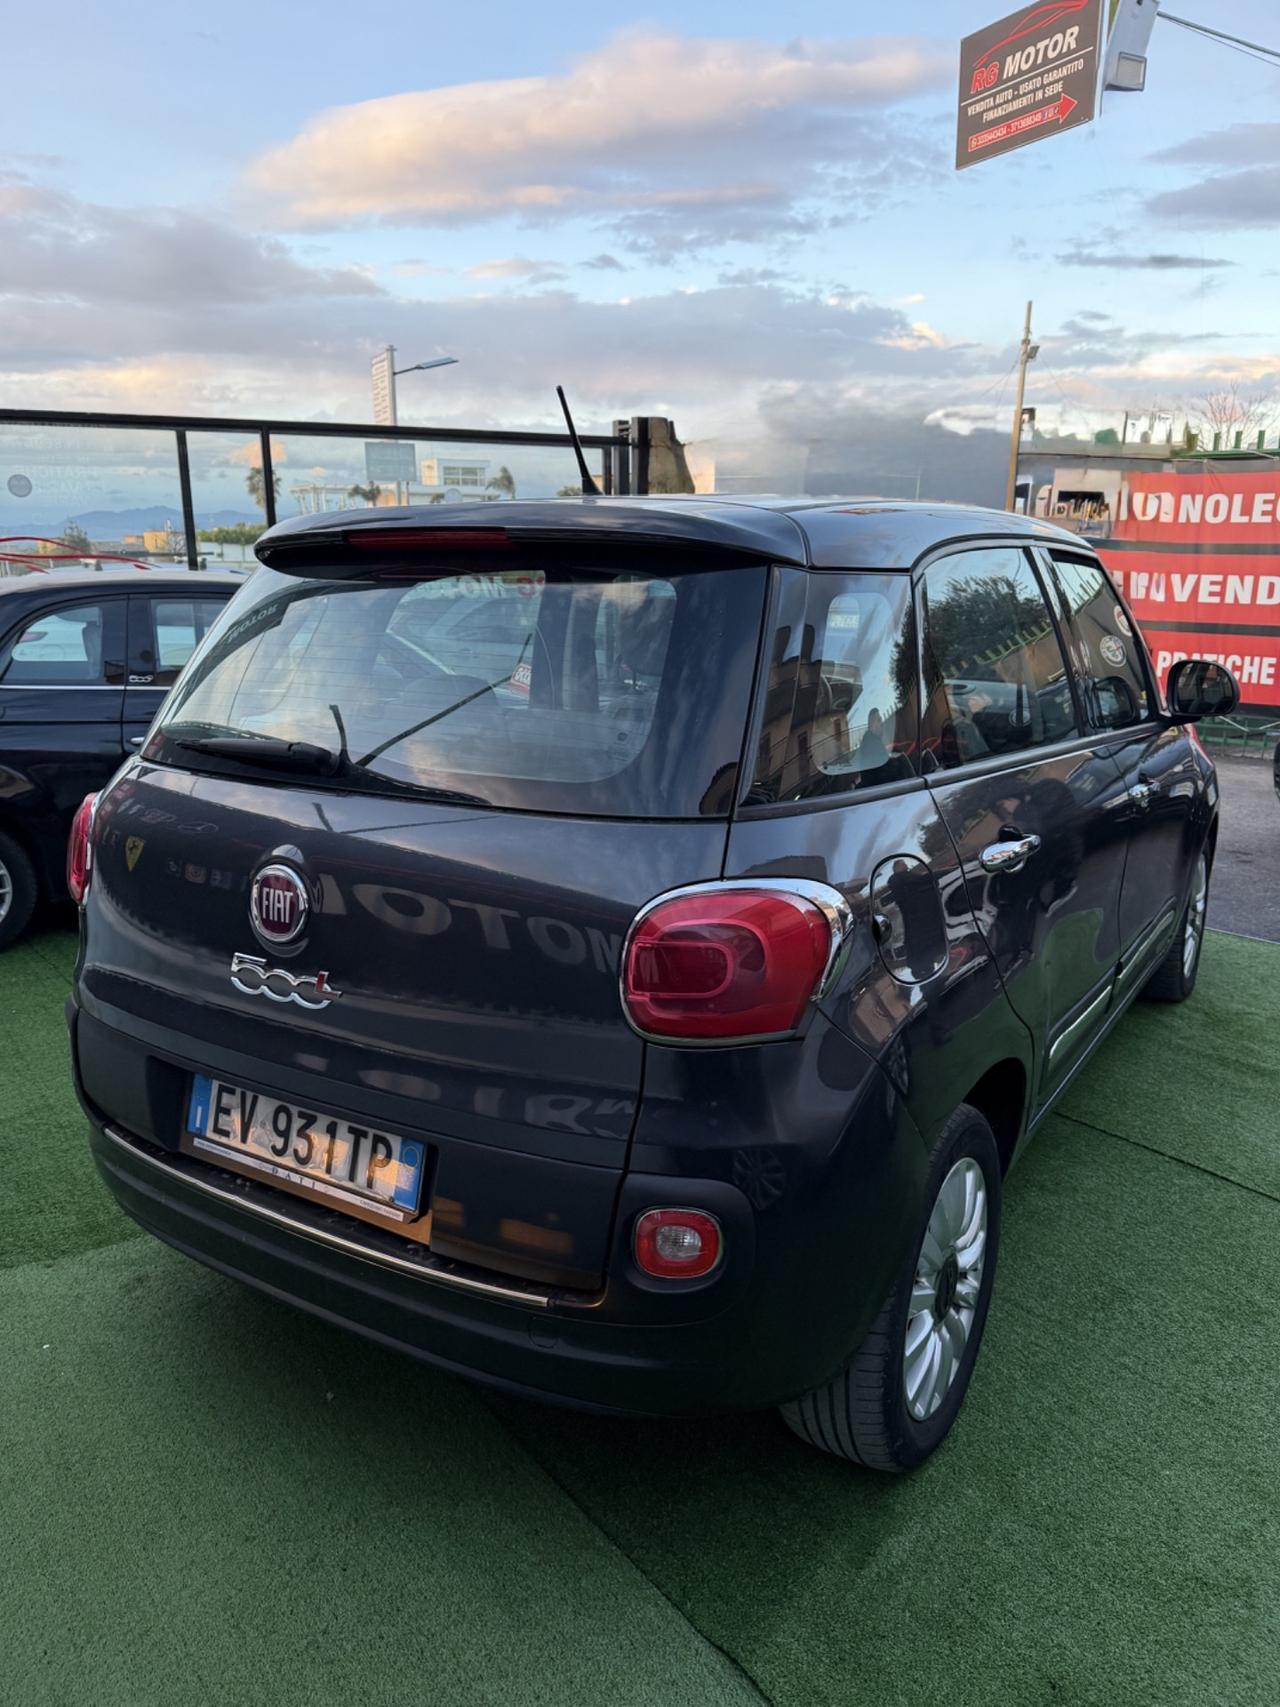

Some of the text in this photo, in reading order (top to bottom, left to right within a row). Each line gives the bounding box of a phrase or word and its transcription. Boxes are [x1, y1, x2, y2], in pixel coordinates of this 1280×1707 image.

[968, 98, 994, 116] VENDITA
[995, 88, 1013, 106] AUTO
[1019, 76, 1042, 95] USATO
[1043, 58, 1084, 85] GARANTITO
[971, 25, 1080, 94] RG MOTOR
[983, 93, 1034, 123] FINANZIAMENTI
[1035, 89, 1043, 101] IN
[1044, 80, 1064, 97] SEDE
[262, 887, 294, 923] FIAT
[230, 952, 343, 1010] 500L
[212, 1084, 259, 1144] EV
[270, 1104, 393, 1189] 931TP
